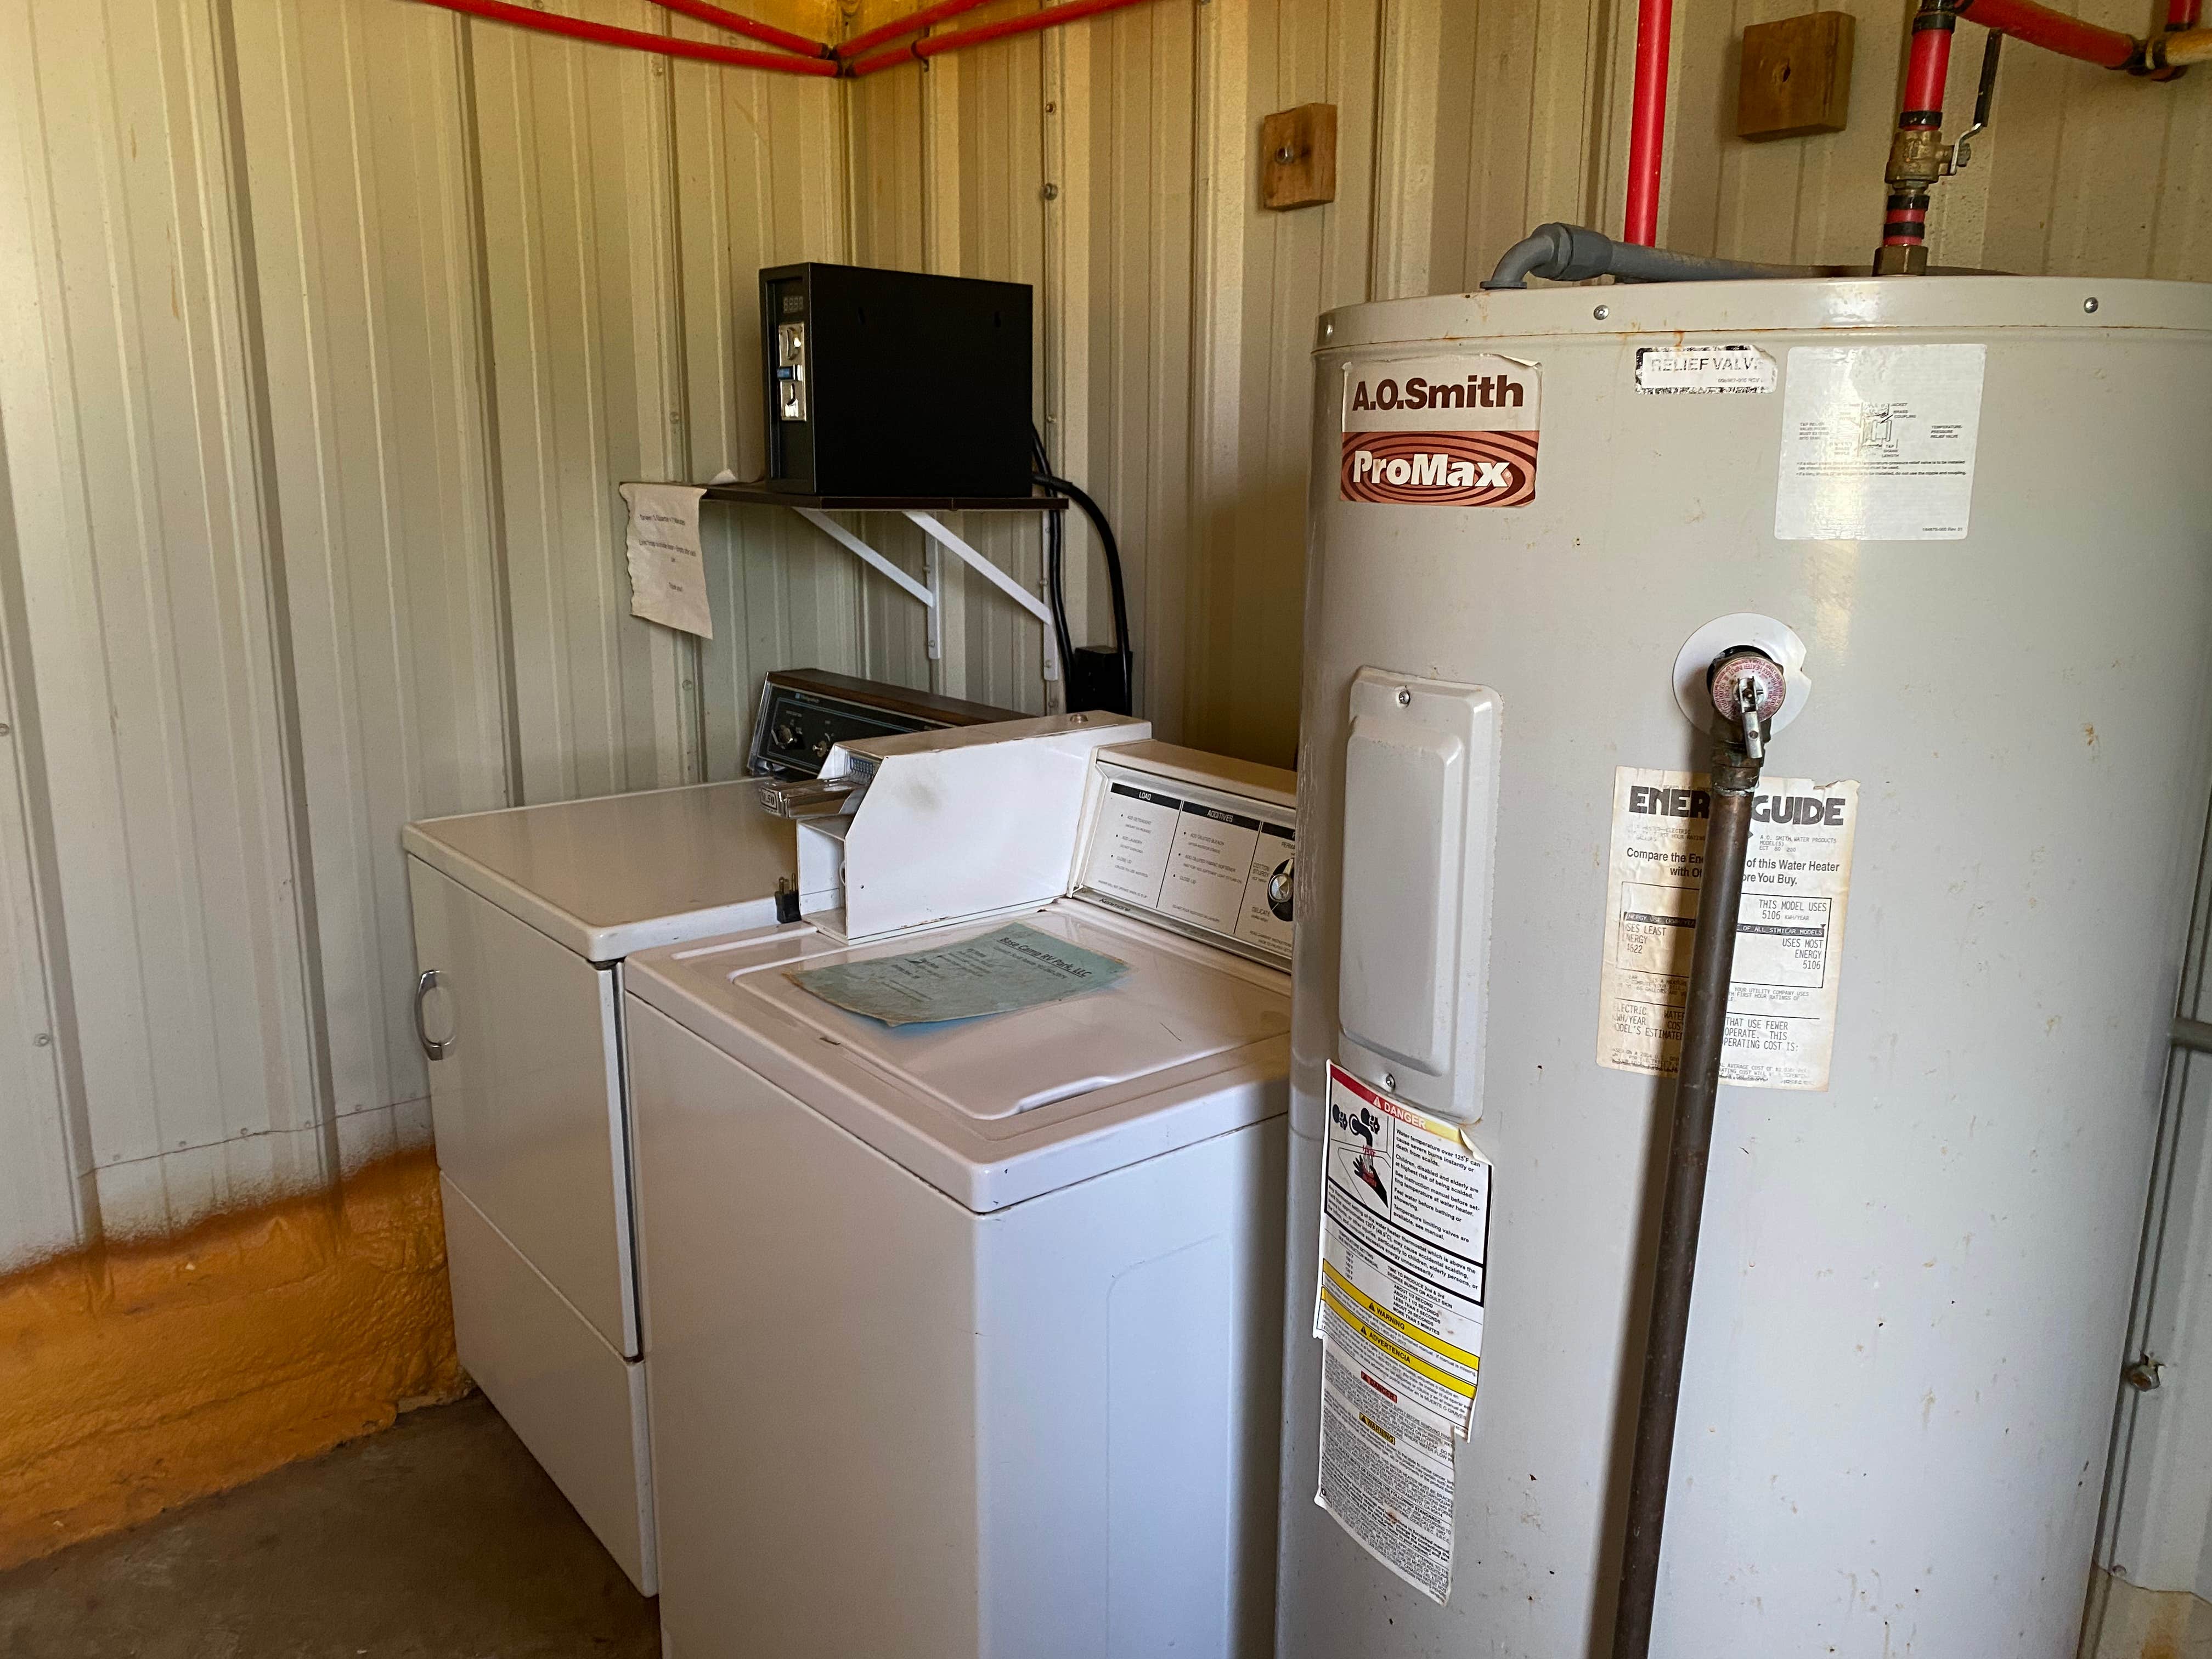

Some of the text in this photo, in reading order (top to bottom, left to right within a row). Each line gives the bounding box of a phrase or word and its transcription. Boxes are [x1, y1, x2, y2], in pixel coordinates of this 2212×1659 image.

[1651, 357, 1709, 371] RELIEF
[1353, 450, 1510, 487] ProMax
[1138, 792, 1152, 800] LOAD
[1207, 810, 1234, 822] ADDITIVES
[1627, 847, 1668, 861] Compare
[1671, 852, 1686, 863] the
[1746, 858, 1839, 872] of this Water Heater
[1670, 866, 1689, 877] with
[1758, 872, 1774, 883] You
[1778, 874, 1797, 887] Buy.
[1098, 898, 1131, 912] Kenmore
[1759, 899, 1827, 912] THIS MODEL USES
[1762, 910, 1781, 919] 5106
[1644, 925, 1667, 936] LEAST
[1782, 938, 1824, 949] USES MOST
[1795, 949, 1822, 959] ENERGY
[1000, 937, 1019, 947] Base
[1018, 945, 1041, 956] Camp
[1073, 968, 1092, 977] LLC
[1802, 960, 1821, 969] 5106
[1724, 1028, 1787, 1040] OPERATE. THIS
[1726, 1017, 1788, 1030] THAT USE FEWER
[1724, 1037, 1799, 1052] PERATING COST IS:
[1384, 1102, 1426, 1130] DANGER
[1396, 1128, 1409, 1139] Water
[1410, 1135, 1440, 1152] temperature
[1396, 1136, 1467, 1171] cause severe burns instantly
[1396, 1143, 1440, 1167] death from scalds.
[1396, 1154, 1416, 1168] Children,
[1417, 1165, 1438, 1178] disabled
[1450, 1179, 1469, 1190] elderly
[1401, 1164, 1474, 1199] highest risk being scalded.
[1404, 1175, 1468, 1206] instruction manual before
[1404, 1182, 1474, 1217] temperature water heater.
[1394, 1187, 1455, 1220] Feel water before bathing
[1393, 1204, 1459, 1239] Temperature limiting valves
[1424, 1228, 1444, 1240] manual.
[1375, 1220, 1387, 1230] water
[1387, 1227, 1401, 1238] heater
[1401, 1236, 1427, 1252] thermostat
[1427, 1250, 1443, 1260] which
[1449, 1260, 1466, 1270] above
[1385, 1247, 1400, 1261] energy
[1378, 1237, 1470, 1288] particularly children, elderly persons,
[1404, 1245, 1469, 1279] cause accidental scalding,
[1403, 1274, 1424, 1289] PRODUCE
[1404, 1281, 1441, 1303] BURNS ADULT
[1393, 1284, 1434, 1308] ABOUT SECOND
[1393, 1290, 1439, 1317] ABOUT SECONDS
[1376, 1307, 1405, 1330] WARNING
[1393, 1301, 1434, 1327] ABOUT SECONDS
[1405, 1314, 1440, 1335] THAN MINUTES
[1420, 1310, 1441, 1324] SECONDS
[1369, 1333, 1410, 1363] ADVERTENCIA
[1368, 1419, 1393, 1442] WARNING
